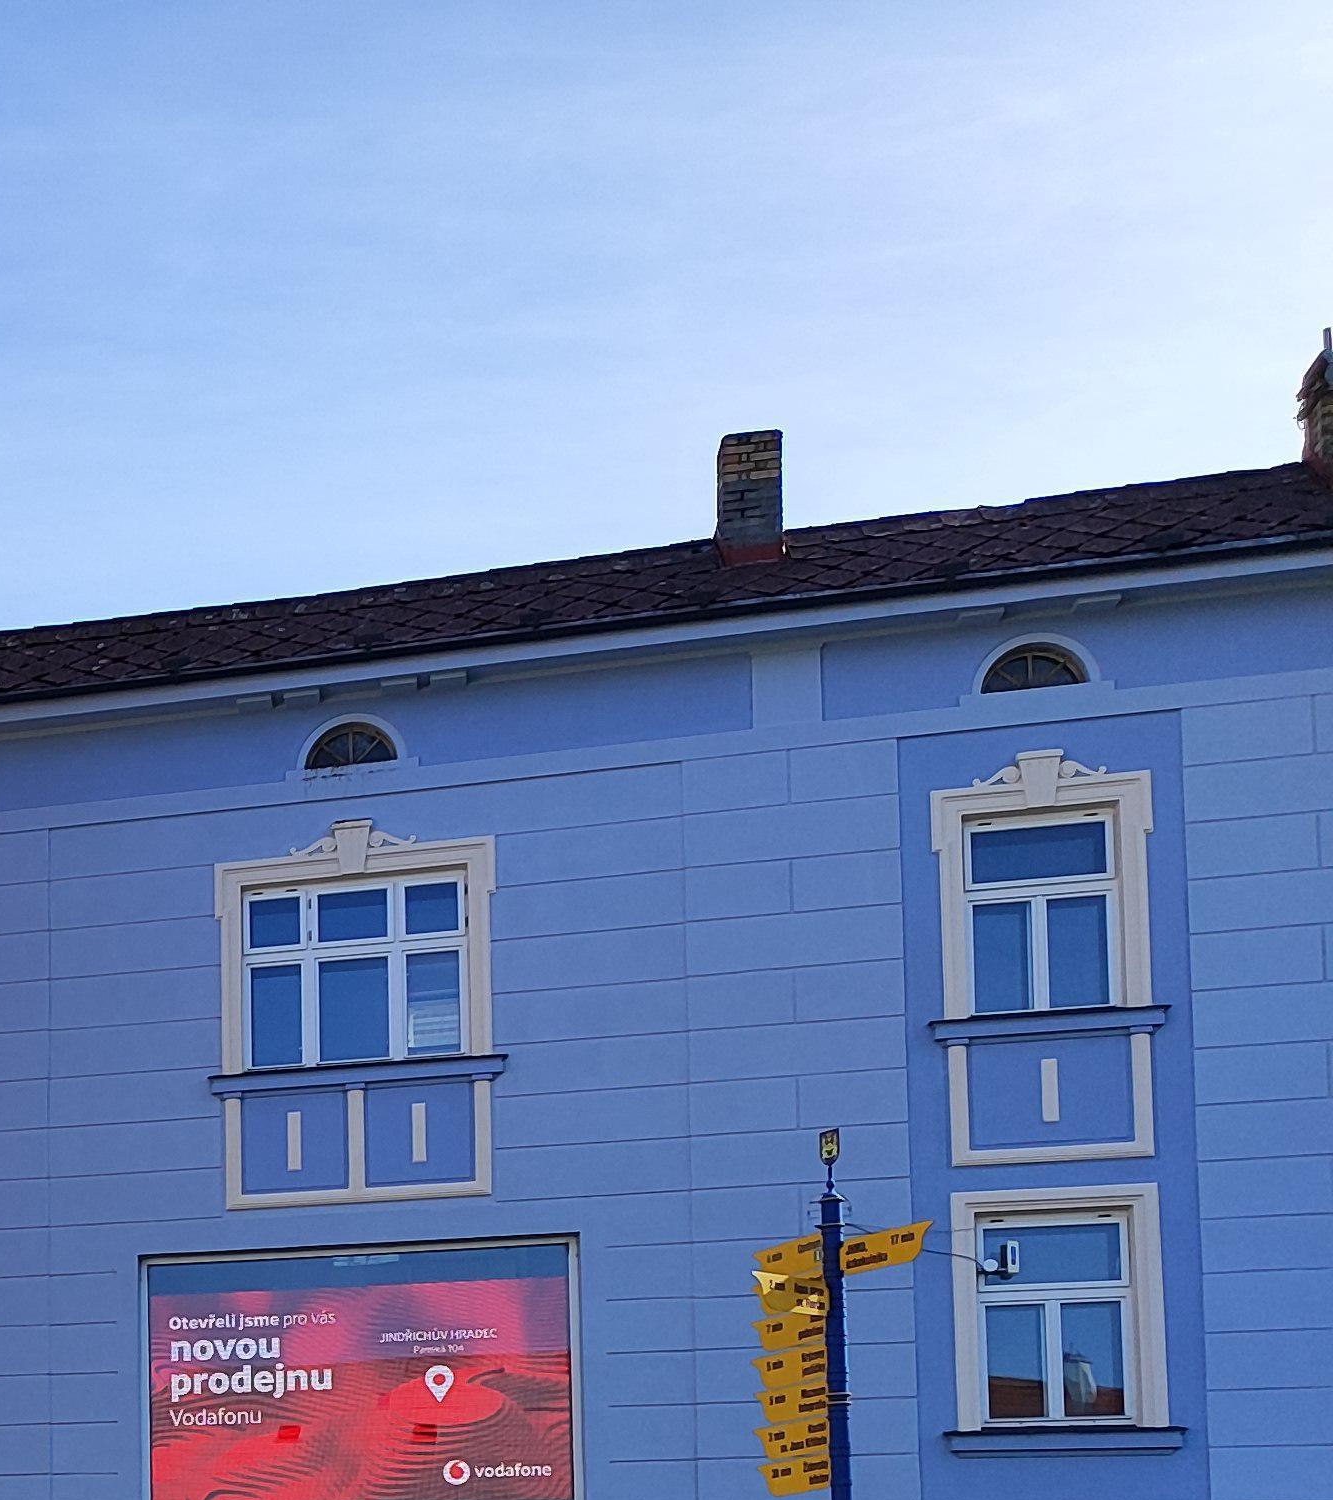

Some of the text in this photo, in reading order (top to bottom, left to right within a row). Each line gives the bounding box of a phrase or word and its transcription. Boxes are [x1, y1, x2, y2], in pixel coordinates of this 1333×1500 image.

[169, 1310, 337, 1331] Otevřeli jsme pro vás
[380, 1328, 498, 1343] JINDŘICHŮV HRADEC
[170, 1336, 281, 1362] novou
[170, 1363, 333, 1403] prodejnu
[169, 1407, 262, 1427] Vodafonu
[474, 1461, 552, 1478] vodafone
